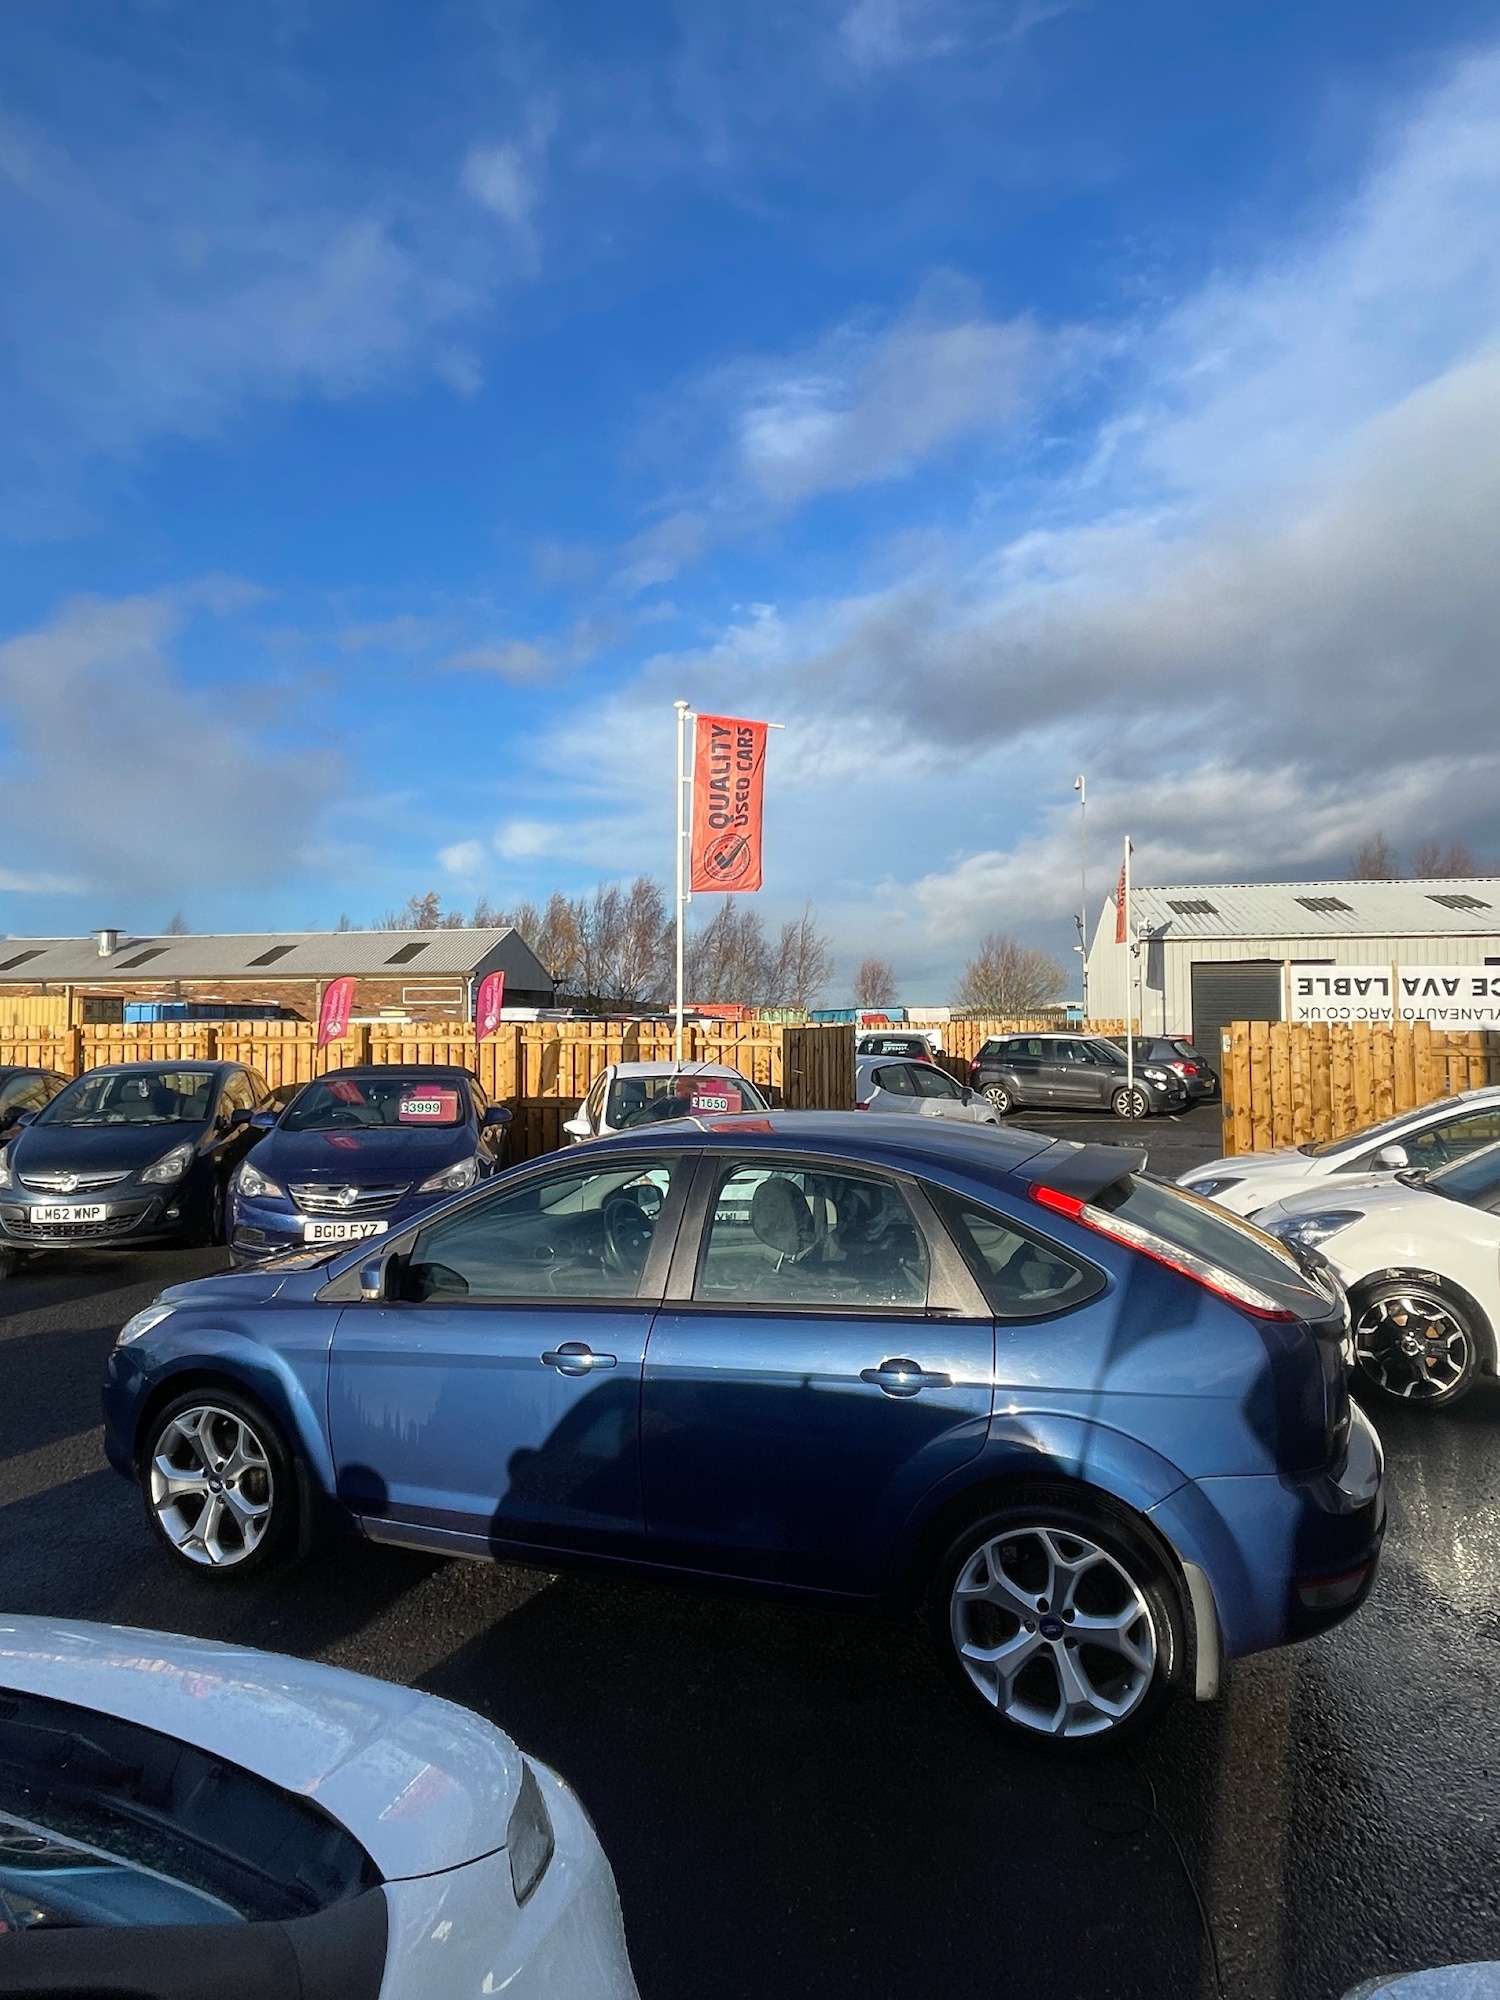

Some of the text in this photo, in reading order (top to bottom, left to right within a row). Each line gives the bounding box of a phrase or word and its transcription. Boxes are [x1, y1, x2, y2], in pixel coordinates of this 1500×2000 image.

[708, 723, 734, 830] QUALITY
[734, 726, 754, 829] USED CARS
[1297, 978, 1461, 996] AVALABLE
[401, 1102, 440, 1113] £3999
[692, 1097, 727, 1109] £1650
[36, 1207, 100, 1220] LM62 WNP
[314, 1225, 345, 1238] BG13
